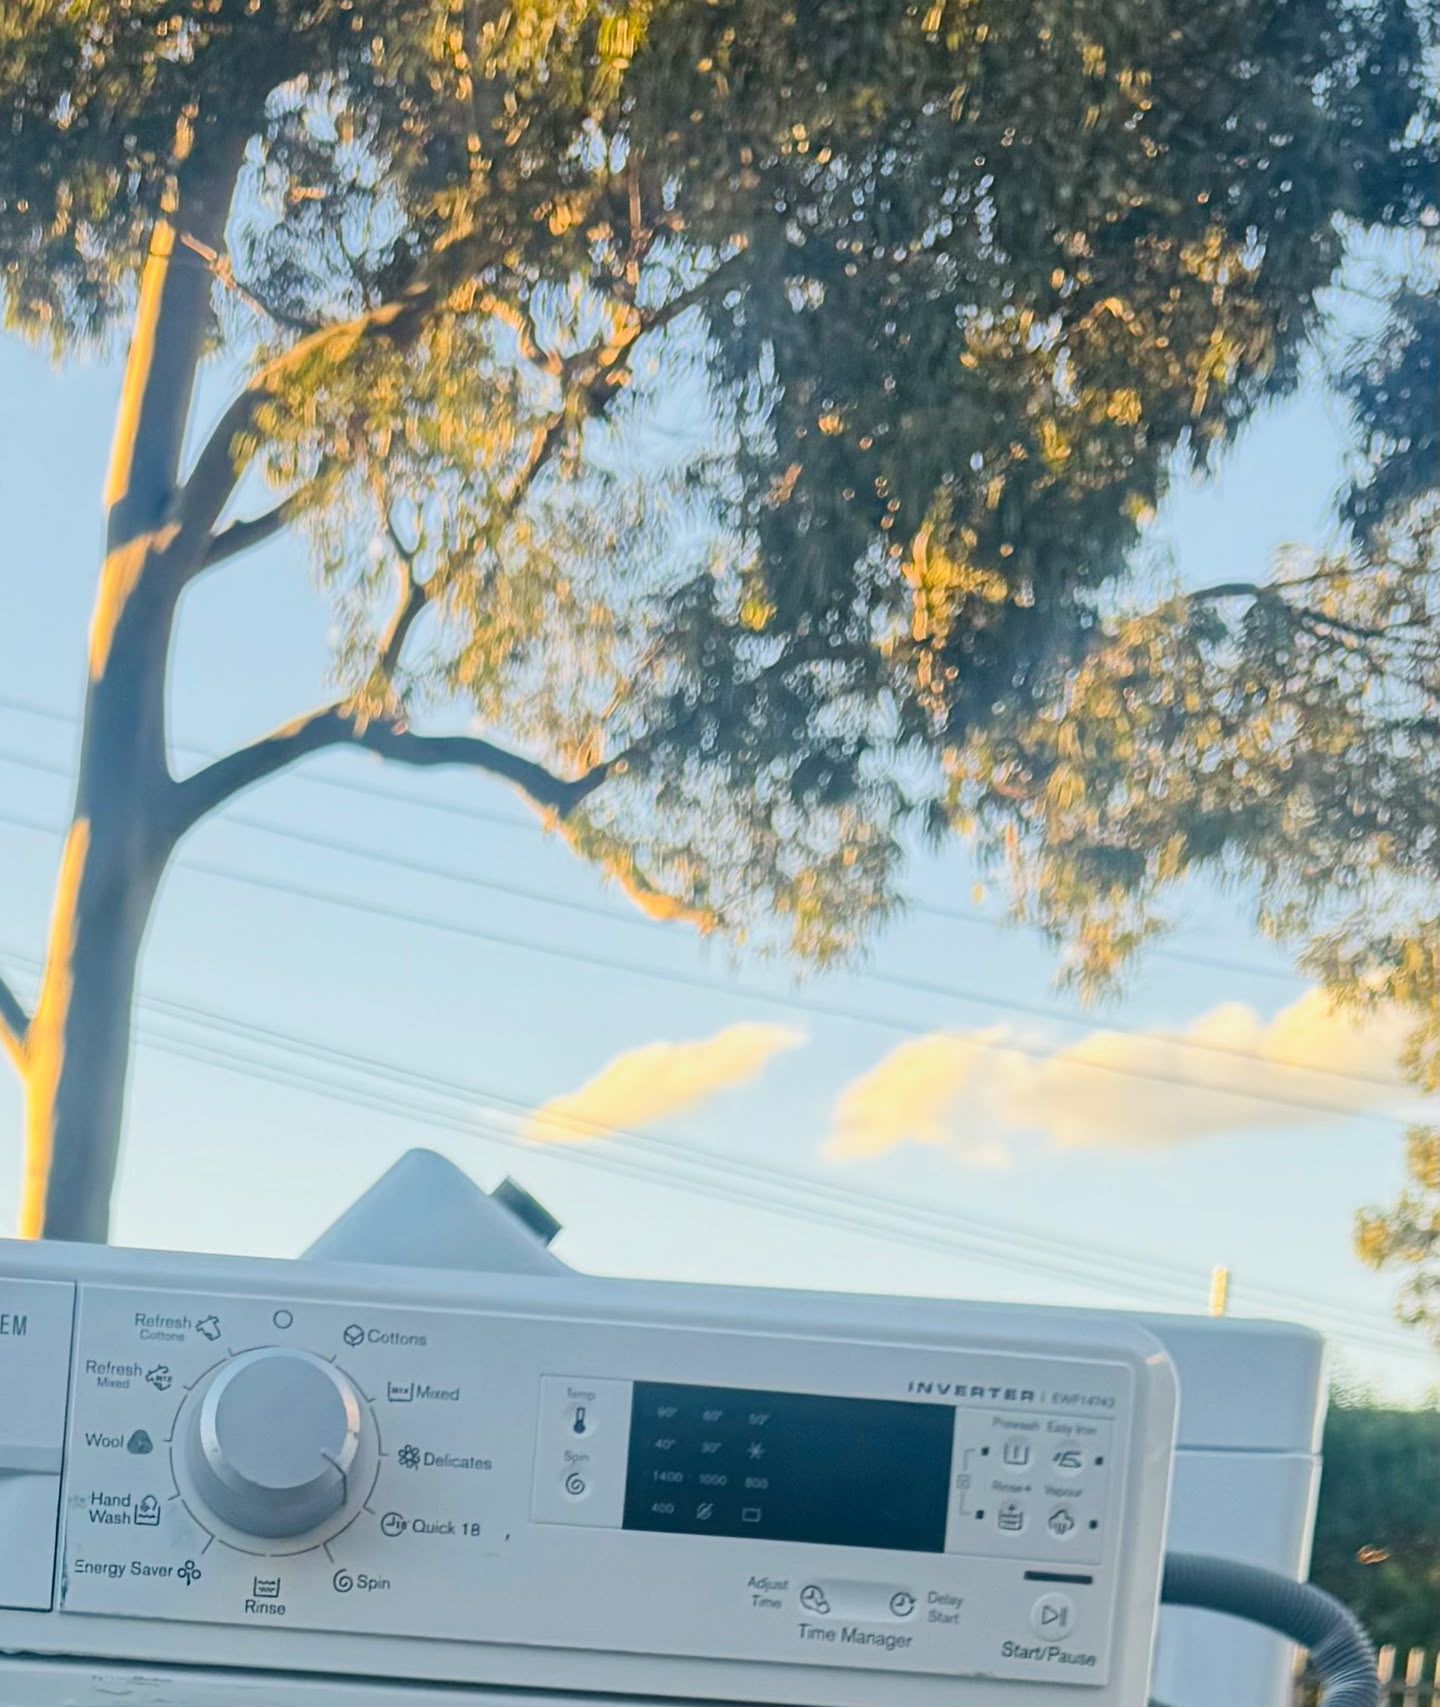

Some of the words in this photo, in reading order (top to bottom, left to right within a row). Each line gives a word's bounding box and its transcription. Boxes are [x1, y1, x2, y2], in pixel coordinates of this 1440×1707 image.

[134, 1312, 191, 1331] Refresh
[140, 1328, 185, 1343] Cottons
[367, 1329, 427, 1347] Cottons
[85, 1360, 142, 1378] Refresh
[97, 1376, 130, 1389] Mixed
[908, 1381, 1035, 1402] INVERTER
[417, 1384, 459, 1402] Mixed
[86, 1433, 124, 1449] Wool
[423, 1452, 492, 1471] Delicates
[564, 1449, 589, 1465] Spin
[91, 1491, 131, 1508] Hand
[89, 1509, 131, 1526] Wash
[413, 1519, 456, 1536] Quick
[461, 1521, 481, 1538] 18
[75, 1559, 126, 1580] Energy
[131, 1560, 173, 1578] Saver
[357, 1574, 391, 1593] Spin
[748, 1575, 789, 1595] Adjust
[244, 1599, 287, 1616] Rinse
[752, 1594, 782, 1610] Time
[927, 1591, 964, 1611] Delay
[928, 1608, 960, 1626] Start
[798, 1622, 837, 1643] Time
[841, 1627, 913, 1651] Manager
[1001, 1640, 1097, 1668] Start/Pause
